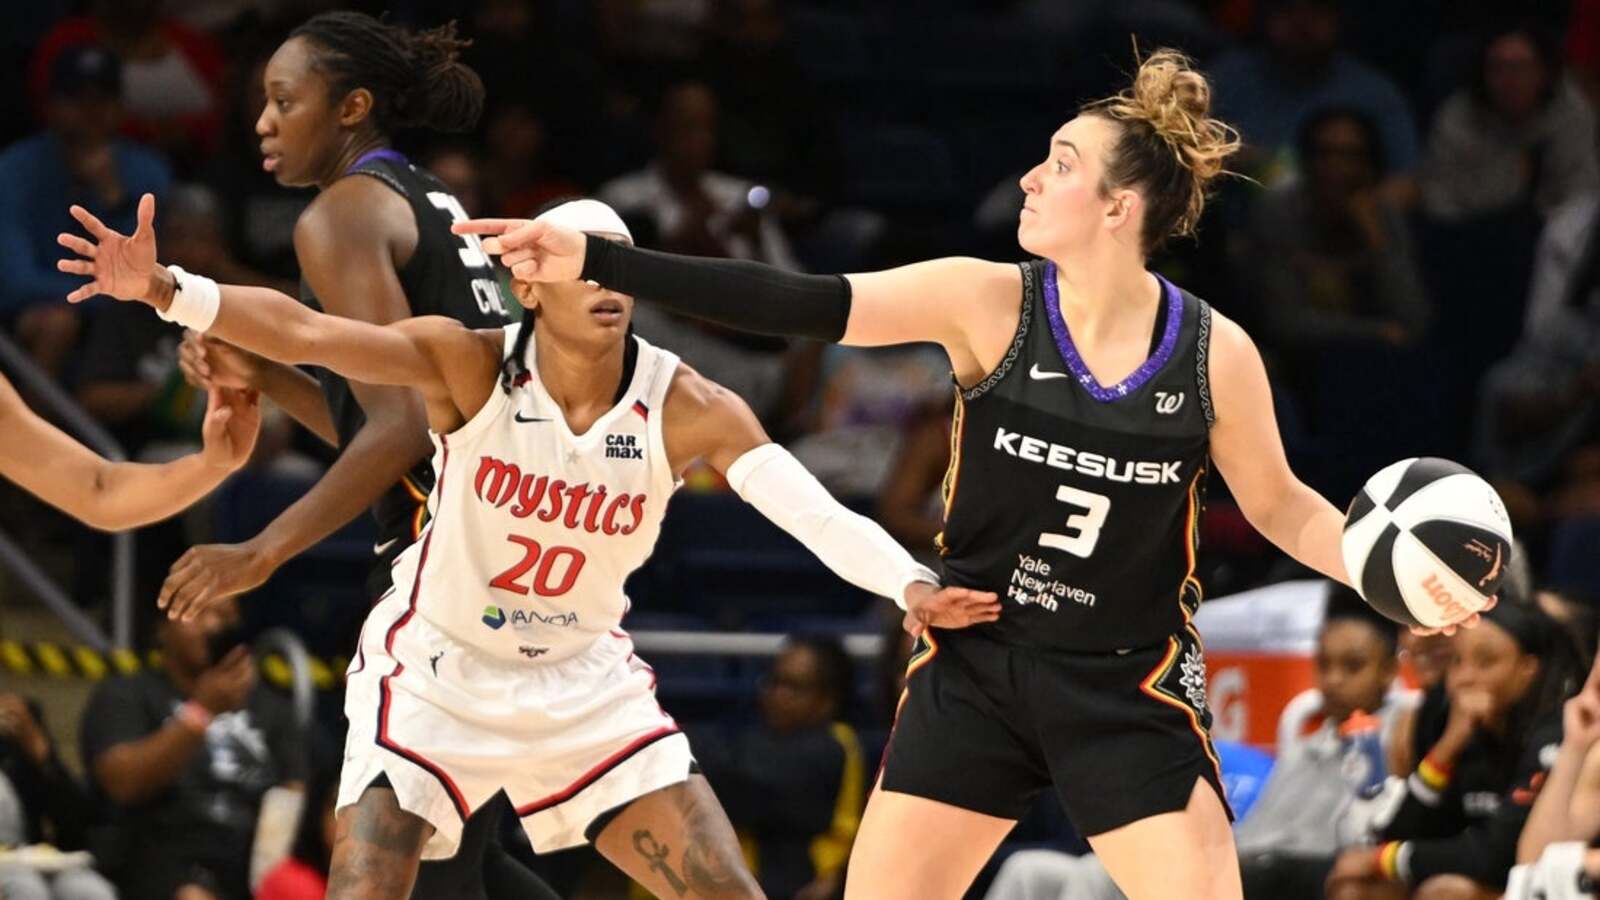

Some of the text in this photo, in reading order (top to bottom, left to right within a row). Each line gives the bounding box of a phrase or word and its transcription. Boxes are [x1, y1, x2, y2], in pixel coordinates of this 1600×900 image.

[605, 434, 636, 447] CAR
[605, 447, 643, 460] max
[993, 427, 1182, 484] KEESUSK
[1038, 485, 1111, 558] 3
[489, 534, 587, 597] 20
[1018, 554, 1051, 576] Yale
[1011, 569, 1046, 593] New
